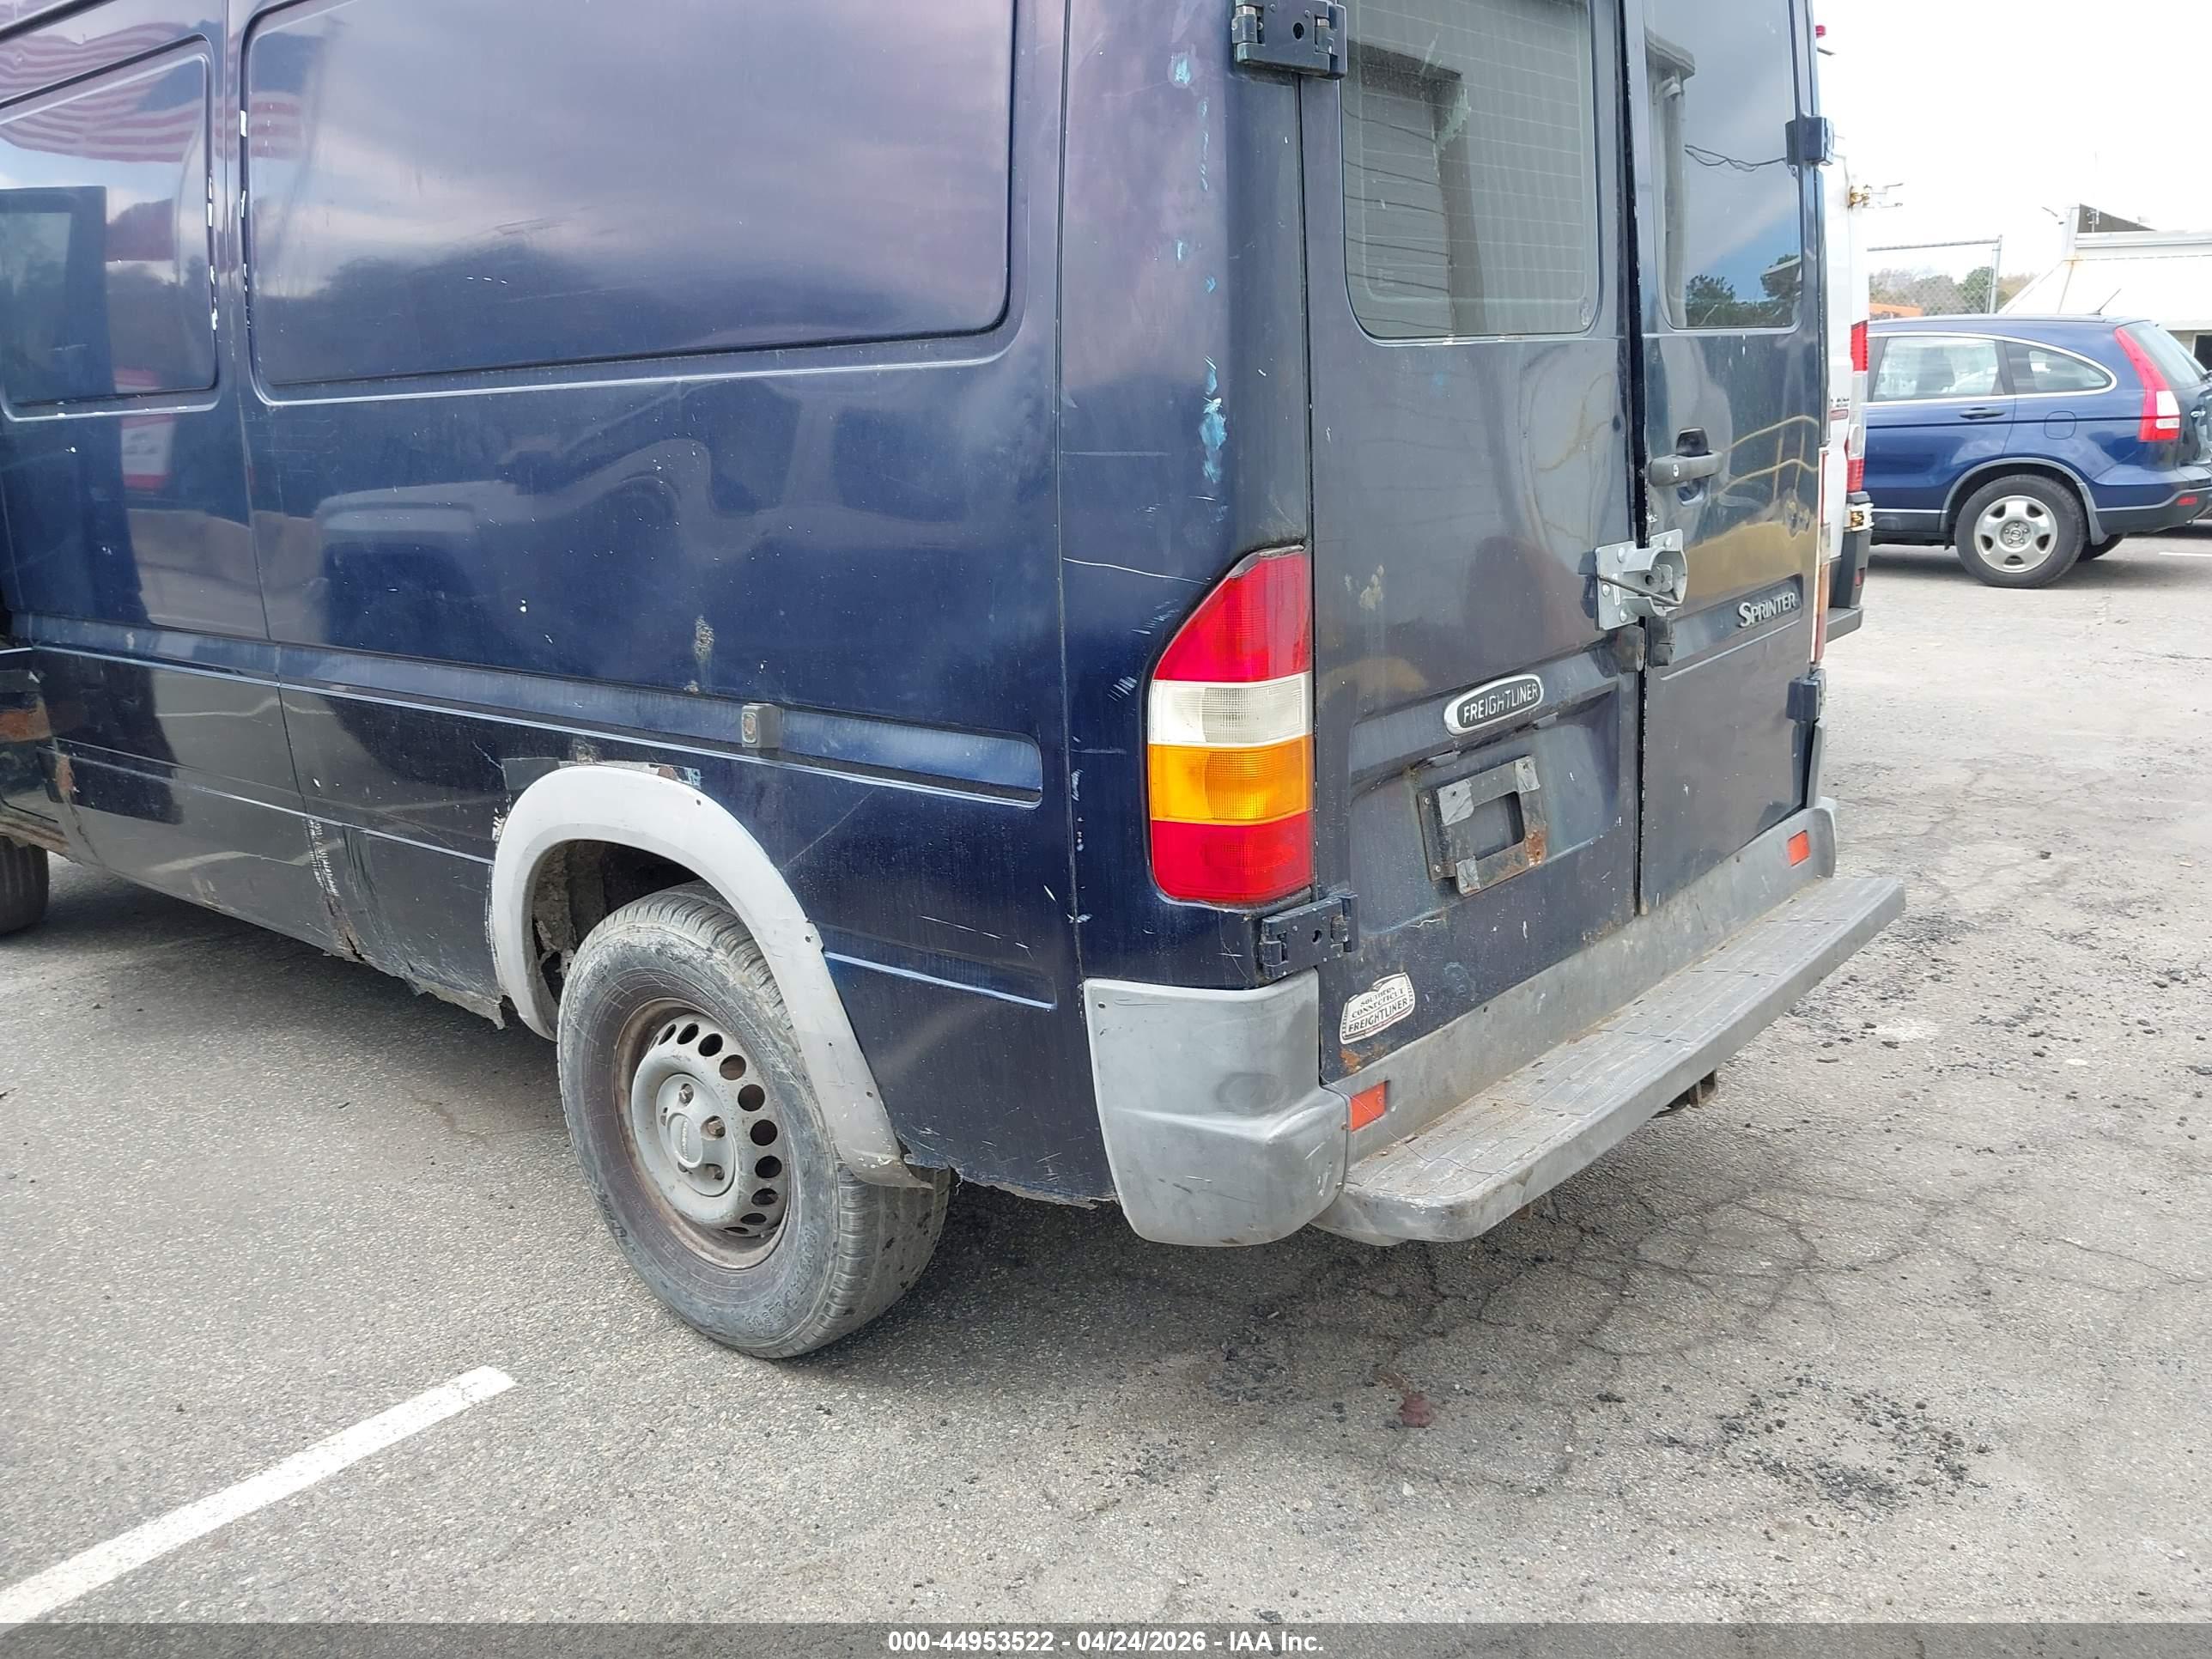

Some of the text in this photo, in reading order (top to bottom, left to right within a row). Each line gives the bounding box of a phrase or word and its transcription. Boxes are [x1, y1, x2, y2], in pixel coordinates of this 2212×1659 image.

[1738, 592, 1796, 627] SPRINTER
[1463, 683, 1539, 724] FREIGHTLINER
[1347, 997, 1408, 1033] FREIGHTLINER
